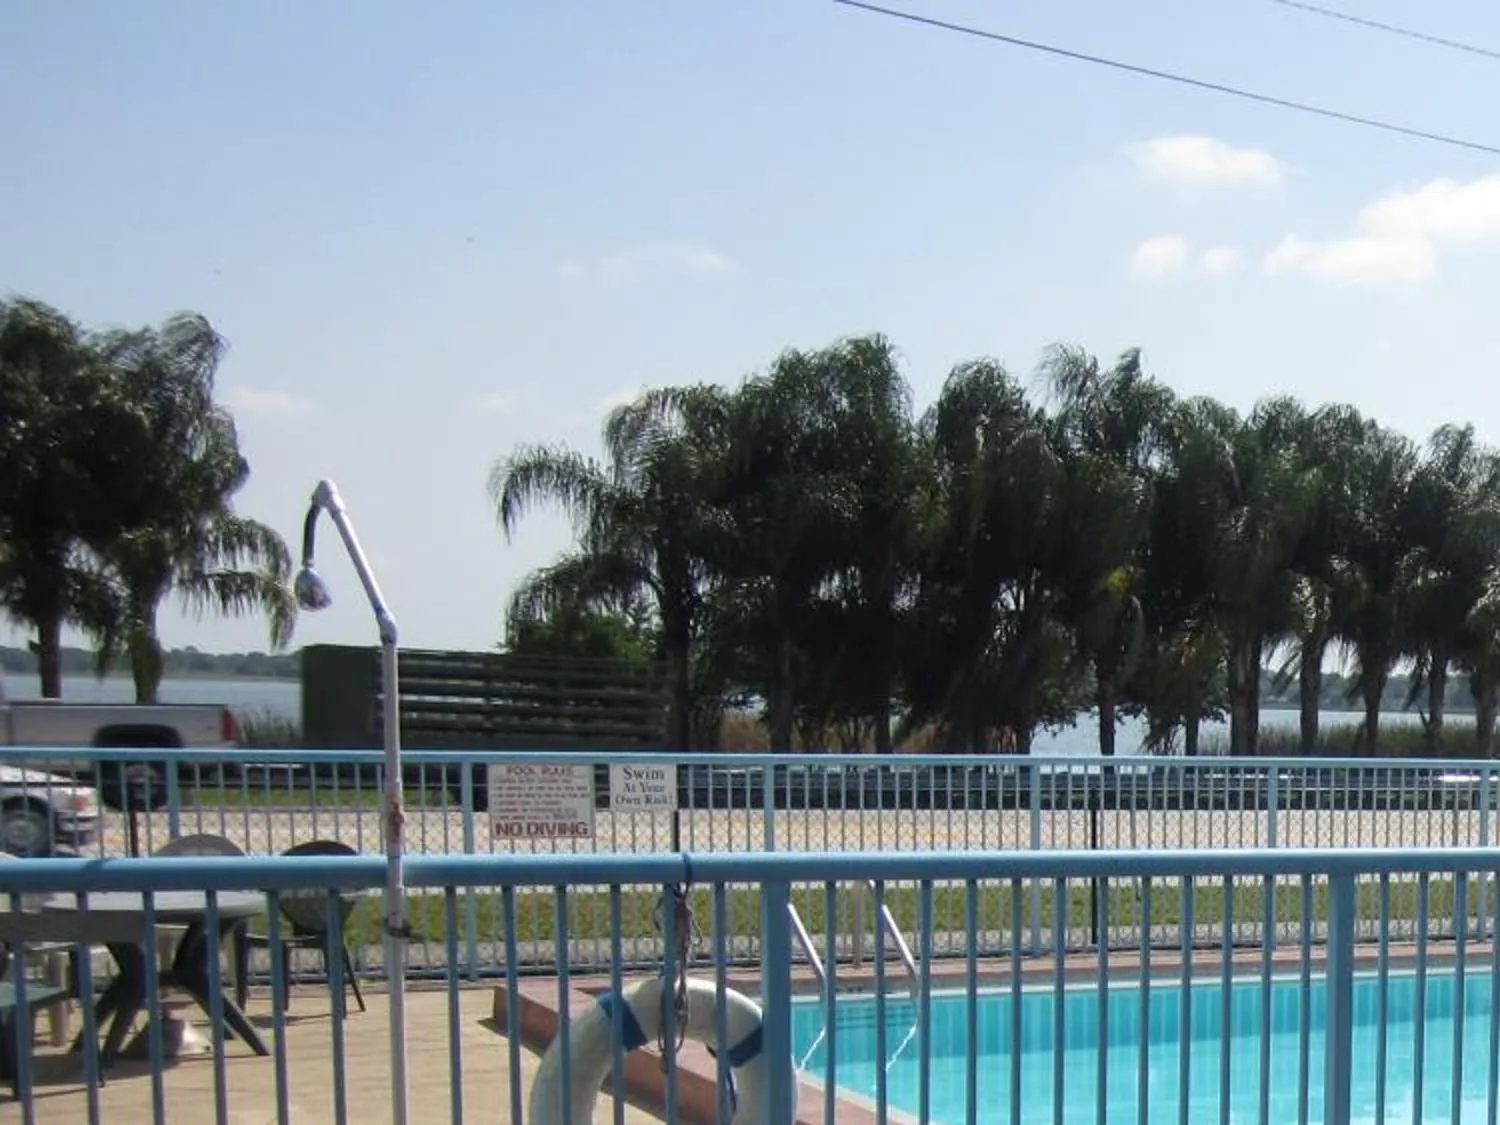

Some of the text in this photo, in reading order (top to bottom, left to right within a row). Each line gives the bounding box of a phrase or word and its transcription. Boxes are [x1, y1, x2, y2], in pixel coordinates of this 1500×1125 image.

[623, 765, 665, 781] Swim
[615, 793, 641, 806] Own
[495, 821, 589, 837] NO DIVING
